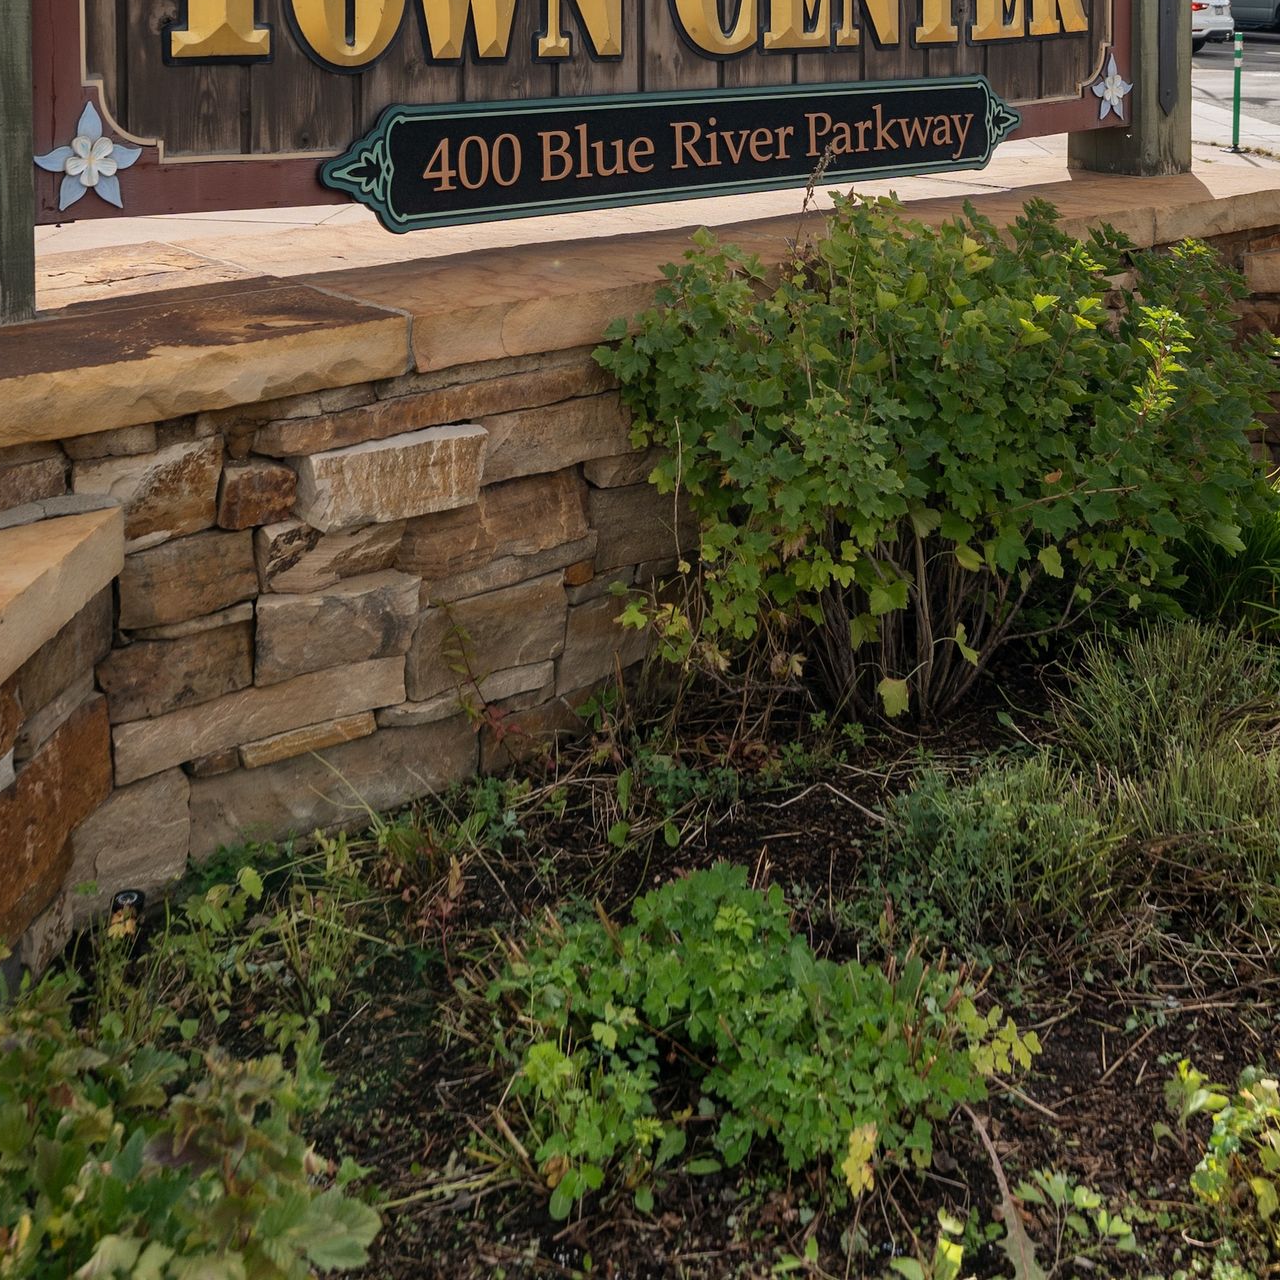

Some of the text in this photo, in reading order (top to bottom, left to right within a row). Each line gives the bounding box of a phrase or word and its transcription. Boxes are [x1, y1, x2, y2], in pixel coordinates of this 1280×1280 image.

[422, 104, 974, 193] 400 Blue River Parkway
